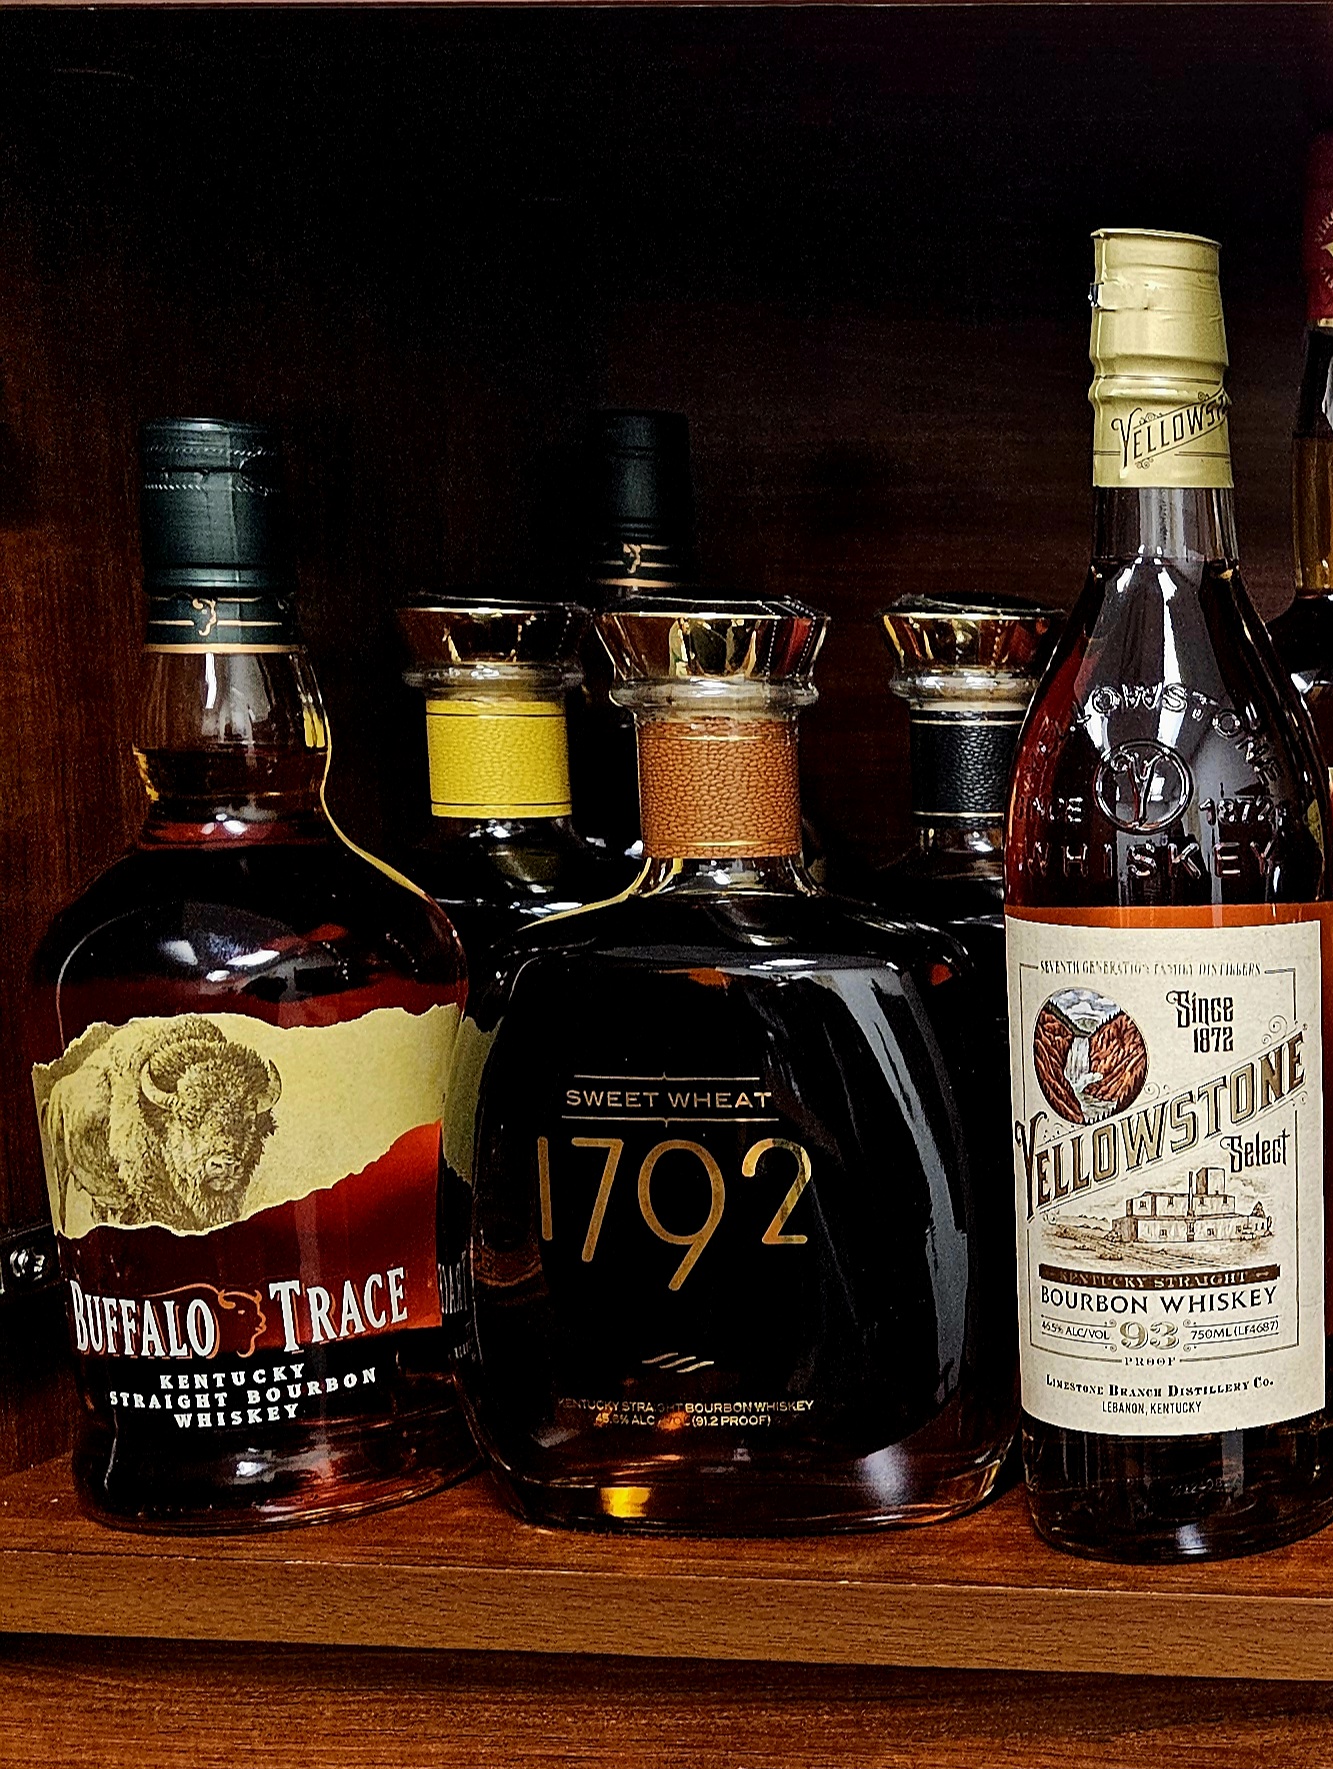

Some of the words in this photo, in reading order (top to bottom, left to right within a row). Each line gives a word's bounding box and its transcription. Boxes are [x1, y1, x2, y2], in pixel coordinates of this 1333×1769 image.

[1166, 989, 1234, 1028] Since
[1193, 1026, 1234, 1053] 1872
[566, 1090, 659, 1108] SWEET
[668, 1091, 772, 1108] WHEAT
[1015, 1031, 1305, 1222] YELLOWSTONE
[1220, 1128, 1290, 1173] Select
[538, 1136, 811, 1291] 1792
[1059, 1270, 1147, 1288] KENTUCKY
[1154, 1273, 1247, 1289] STRAIGHT
[1041, 1284, 1148, 1314] BOURBON
[1160, 1285, 1277, 1314] WHISKEY
[70, 1281, 217, 1359] BUFFALO
[271, 1268, 407, 1353] TRACE
[1065, 1327, 1110, 1340] ALC/VOL
[1119, 1320, 1180, 1350] 93
[1190, 1327, 1232, 1340] 750ML
[1125, 1357, 1176, 1366] PROOF
[111, 1391, 227, 1409] STRAIGHT
[248, 1367, 376, 1404] BOURBON
[160, 1363, 305, 1389] KENTUCKY
[174, 1404, 299, 1428] WHISKEY
[686, 1402, 752, 1413] BOURBON
[754, 1400, 814, 1412] WHISKEY
[1102, 1401, 1148, 1416] LEBANON,
[1151, 1401, 1202, 1414] KENTUCKY
[692, 1416, 718, 1427] (91.2
[721, 1416, 771, 1427] PROOF)
